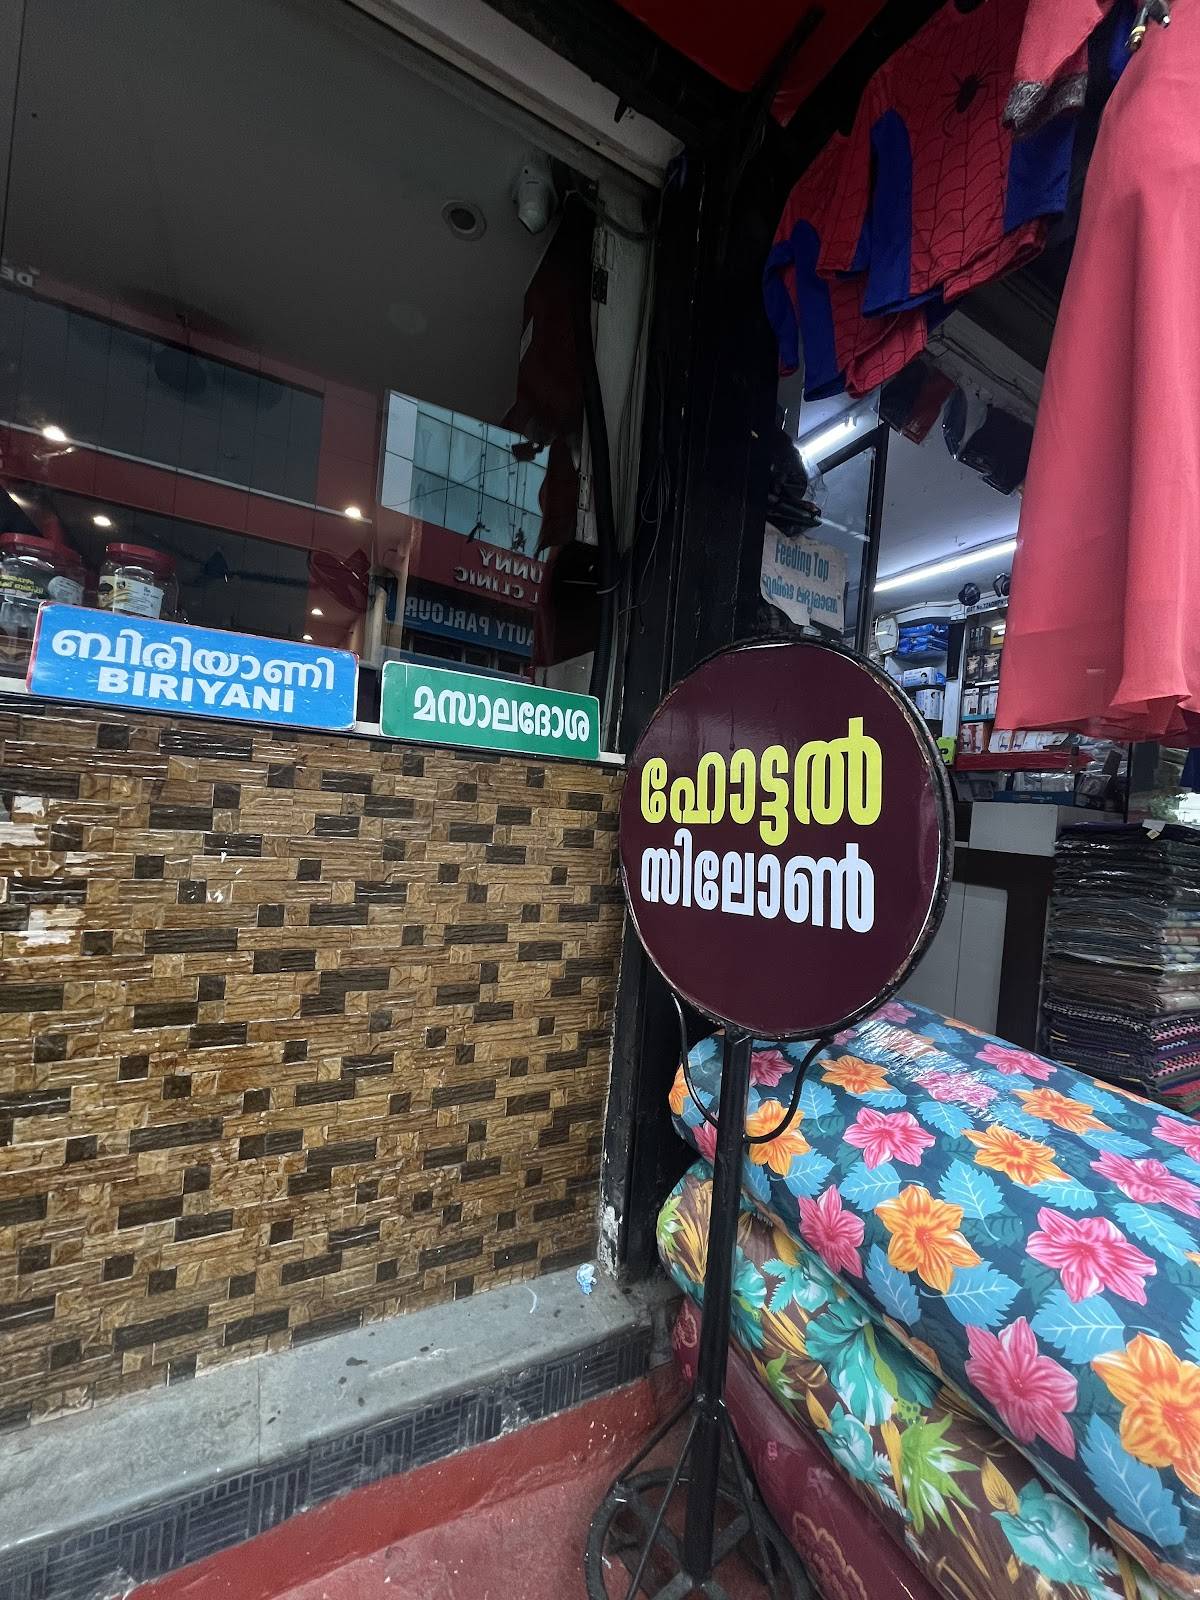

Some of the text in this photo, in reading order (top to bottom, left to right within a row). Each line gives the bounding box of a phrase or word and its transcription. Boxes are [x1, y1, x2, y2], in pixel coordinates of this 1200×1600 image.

[774, 541, 830, 583] Feeding Top
[51, 628, 334, 690] ബിരിയാണി
[97, 667, 294, 713] BIRIYANI
[413, 685, 590, 742] മസാലദോശ
[641, 716, 882, 846] ഹോട്ടൽ
[641, 828, 874, 933] സിലോൺ
